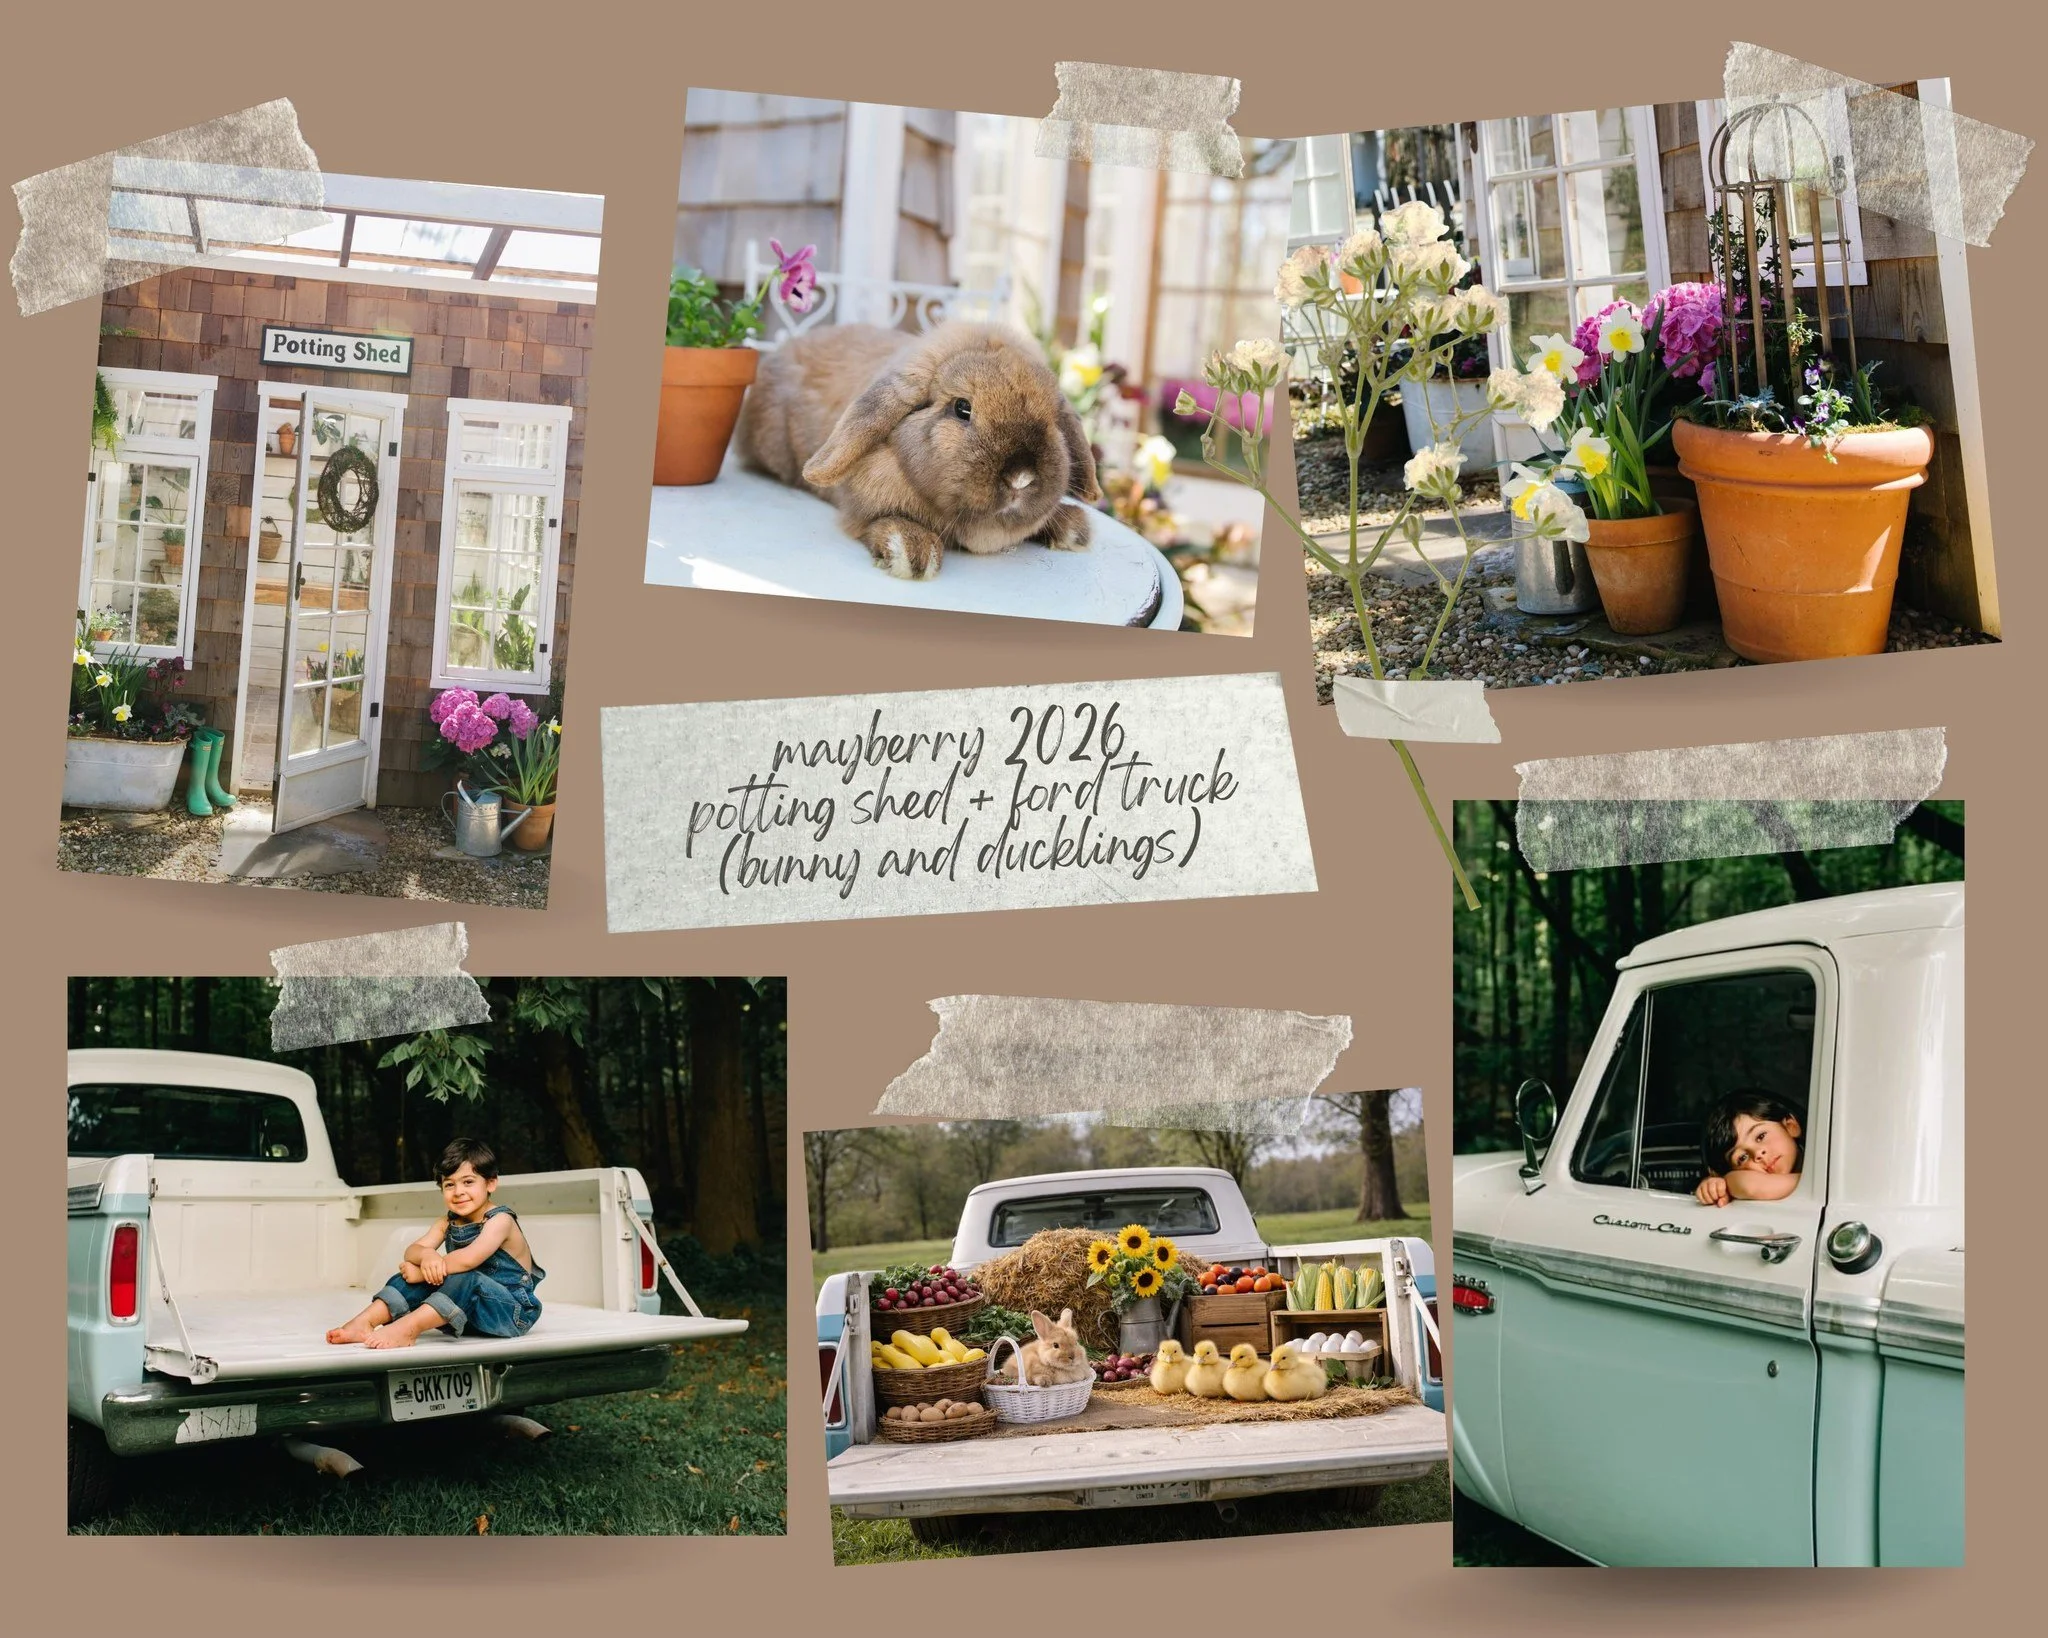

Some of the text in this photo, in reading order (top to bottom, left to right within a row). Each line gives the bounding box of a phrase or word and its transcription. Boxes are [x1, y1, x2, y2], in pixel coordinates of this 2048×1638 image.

[273, 334, 401, 364] Potting Shed
[413, 1372, 473, 1403] GKK709
